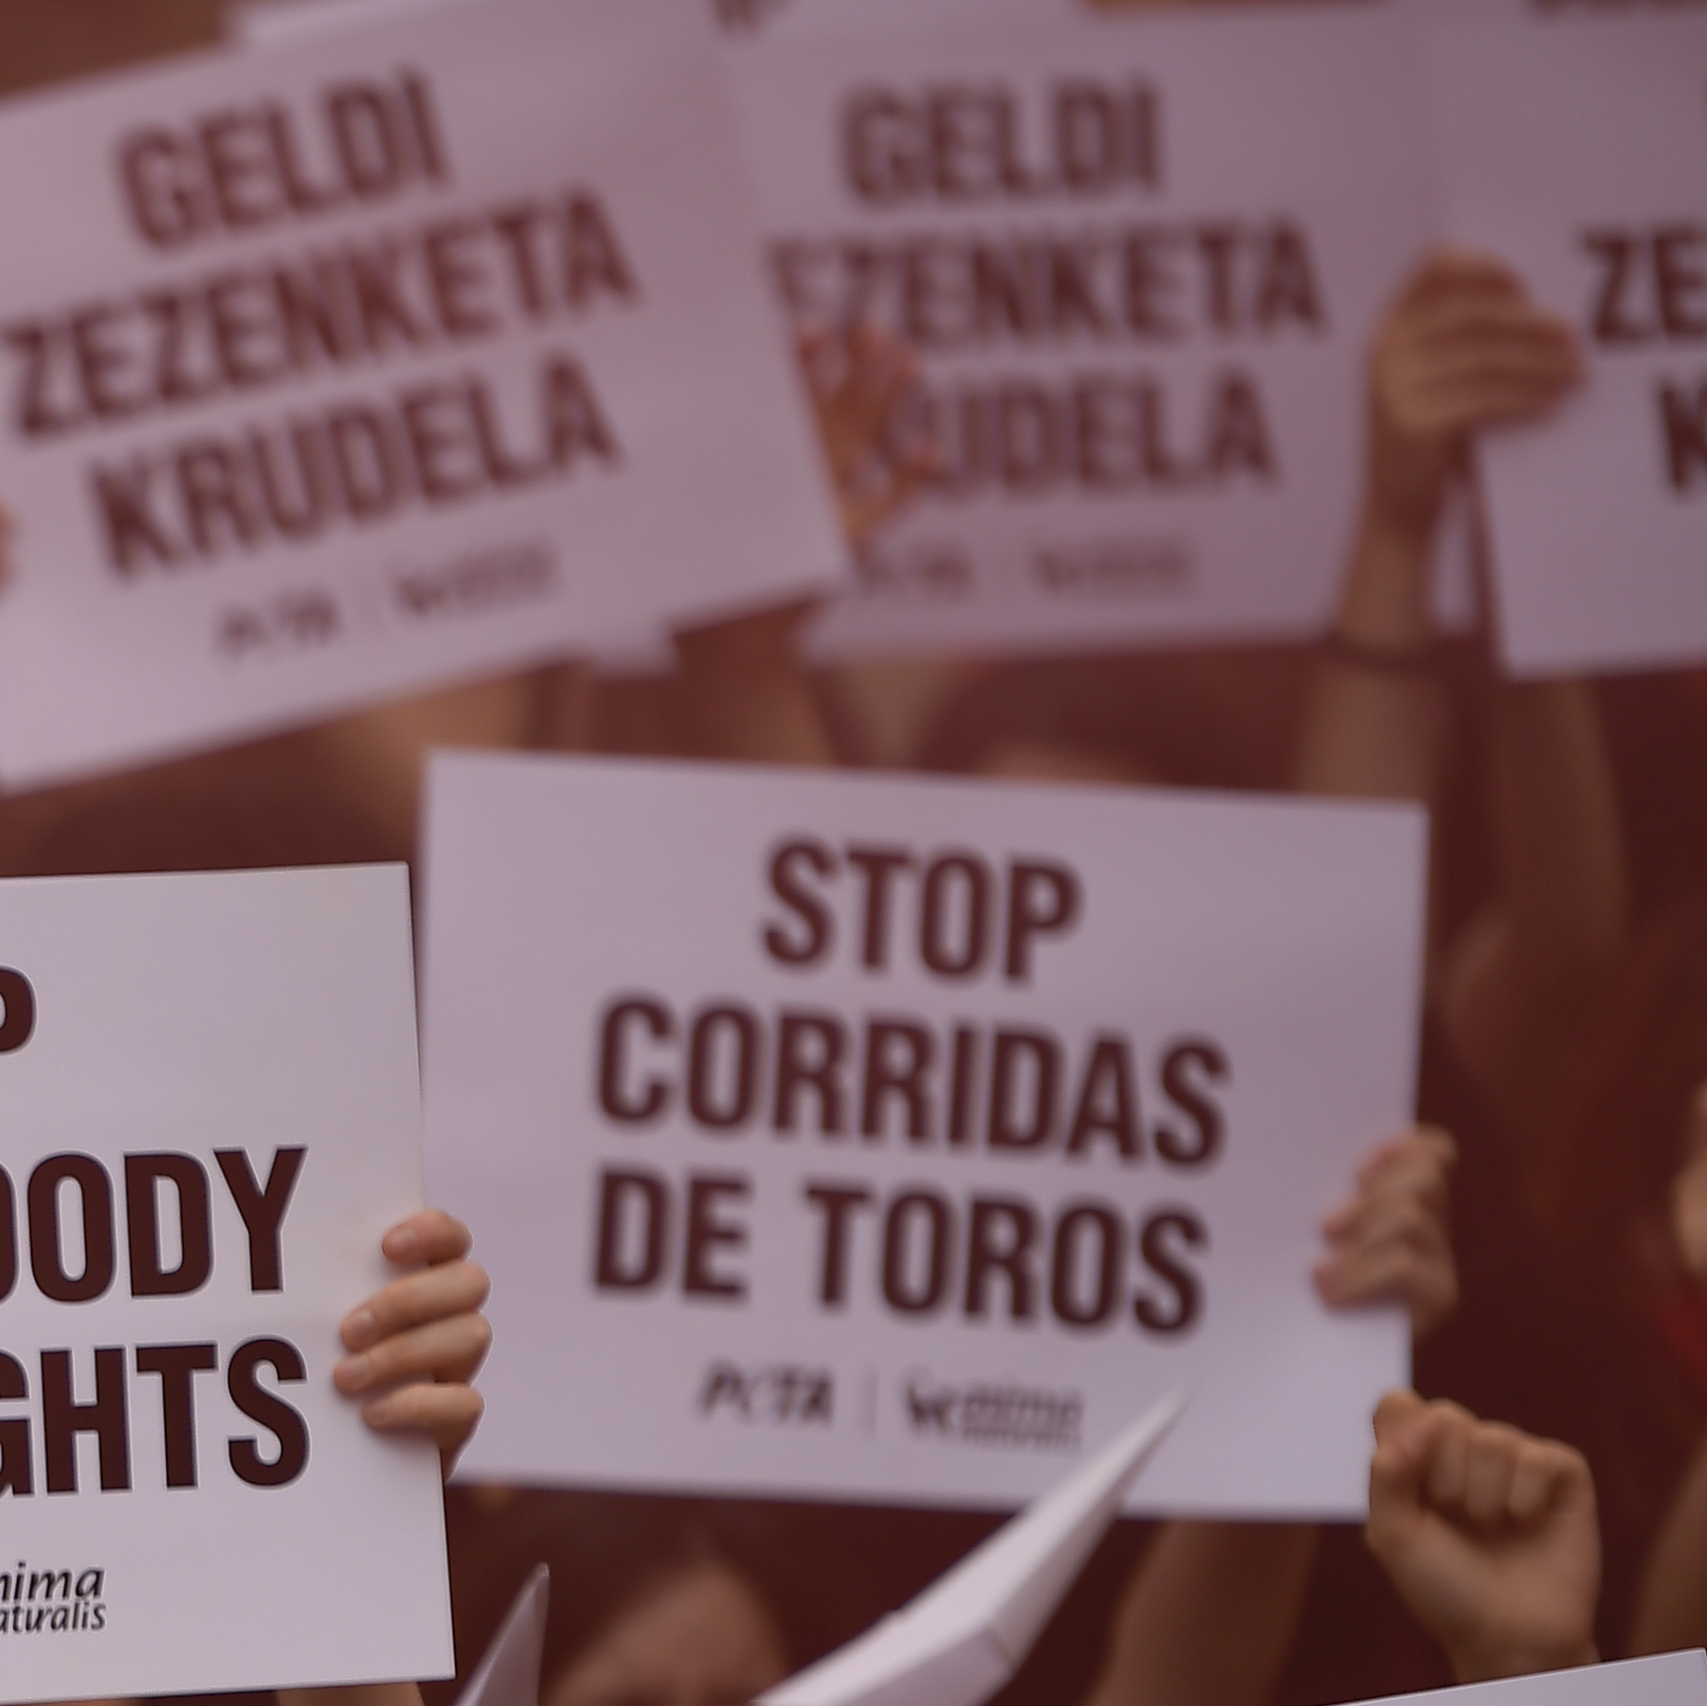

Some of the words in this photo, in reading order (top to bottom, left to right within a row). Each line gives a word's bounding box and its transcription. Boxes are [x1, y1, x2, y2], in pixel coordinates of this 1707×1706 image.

[119, 73, 447, 250] GELDI
[843, 81, 1161, 206] GELDI
[770, 222, 1324, 350] EZENKETA
[91, 353, 618, 574] KRUDELA
[912, 370, 1277, 502] UDELA
[763, 838, 1080, 983] STOP
[597, 997, 1229, 1172] CORRIDAS
[593, 1167, 749, 1301] DE
[805, 1182, 1207, 1338] TOROS
